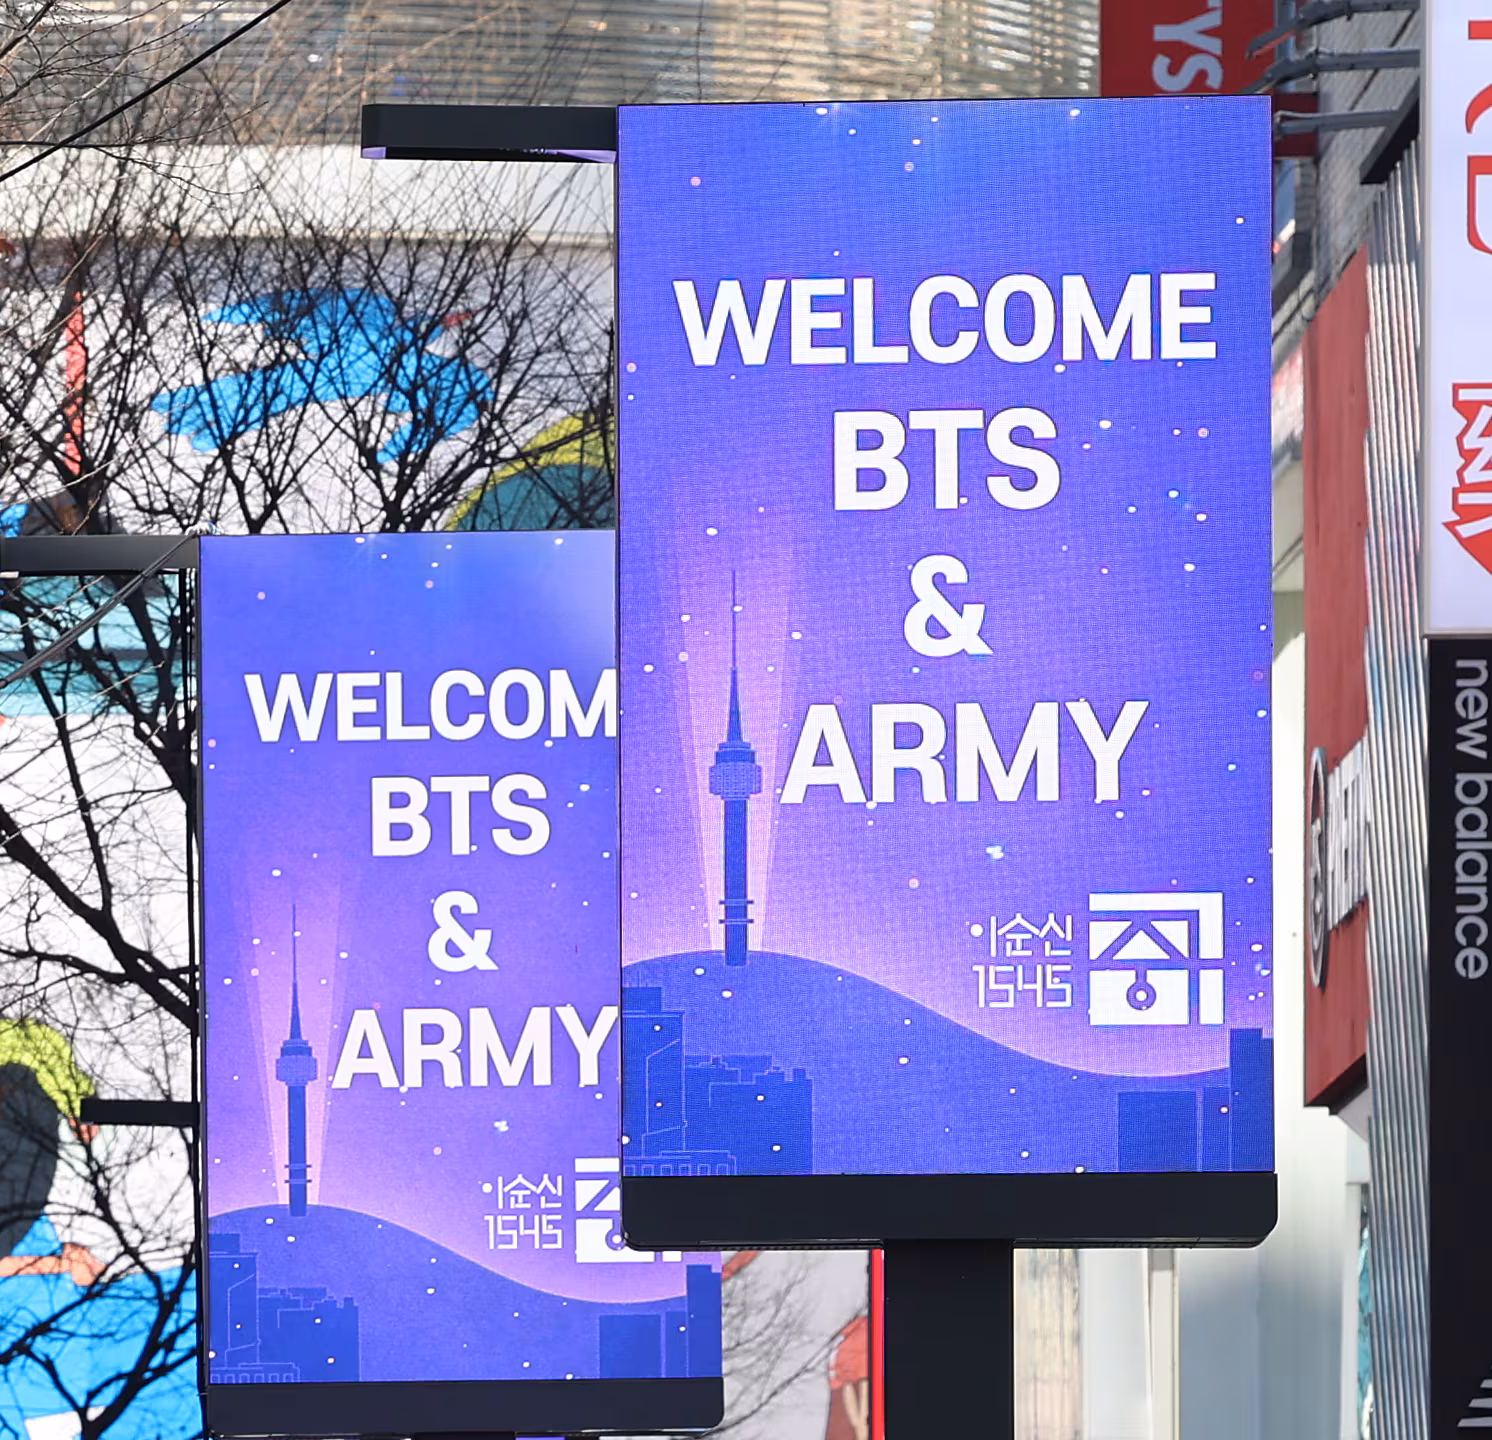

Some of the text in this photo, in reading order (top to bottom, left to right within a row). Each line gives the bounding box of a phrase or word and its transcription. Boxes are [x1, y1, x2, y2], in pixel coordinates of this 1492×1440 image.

[1152, 0, 1224, 92] YS
[673, 272, 1217, 366] WELCOME
[834, 407, 1061, 511] BTS
[903, 554, 994, 657] &
[244, 667, 616, 742] WELCOM
[780, 700, 1149, 804] ARMY
[371, 774, 550, 857] BTS
[1454, 659, 1492, 979] new balance
[427, 890, 498, 972] &
[970, 911, 1073, 959] 이순신
[972, 964, 1073, 1008] 1545
[331, 1004, 617, 1089] ARMY
[482, 1173, 563, 1210] 이순신
[483, 1214, 562, 1250] 1545
